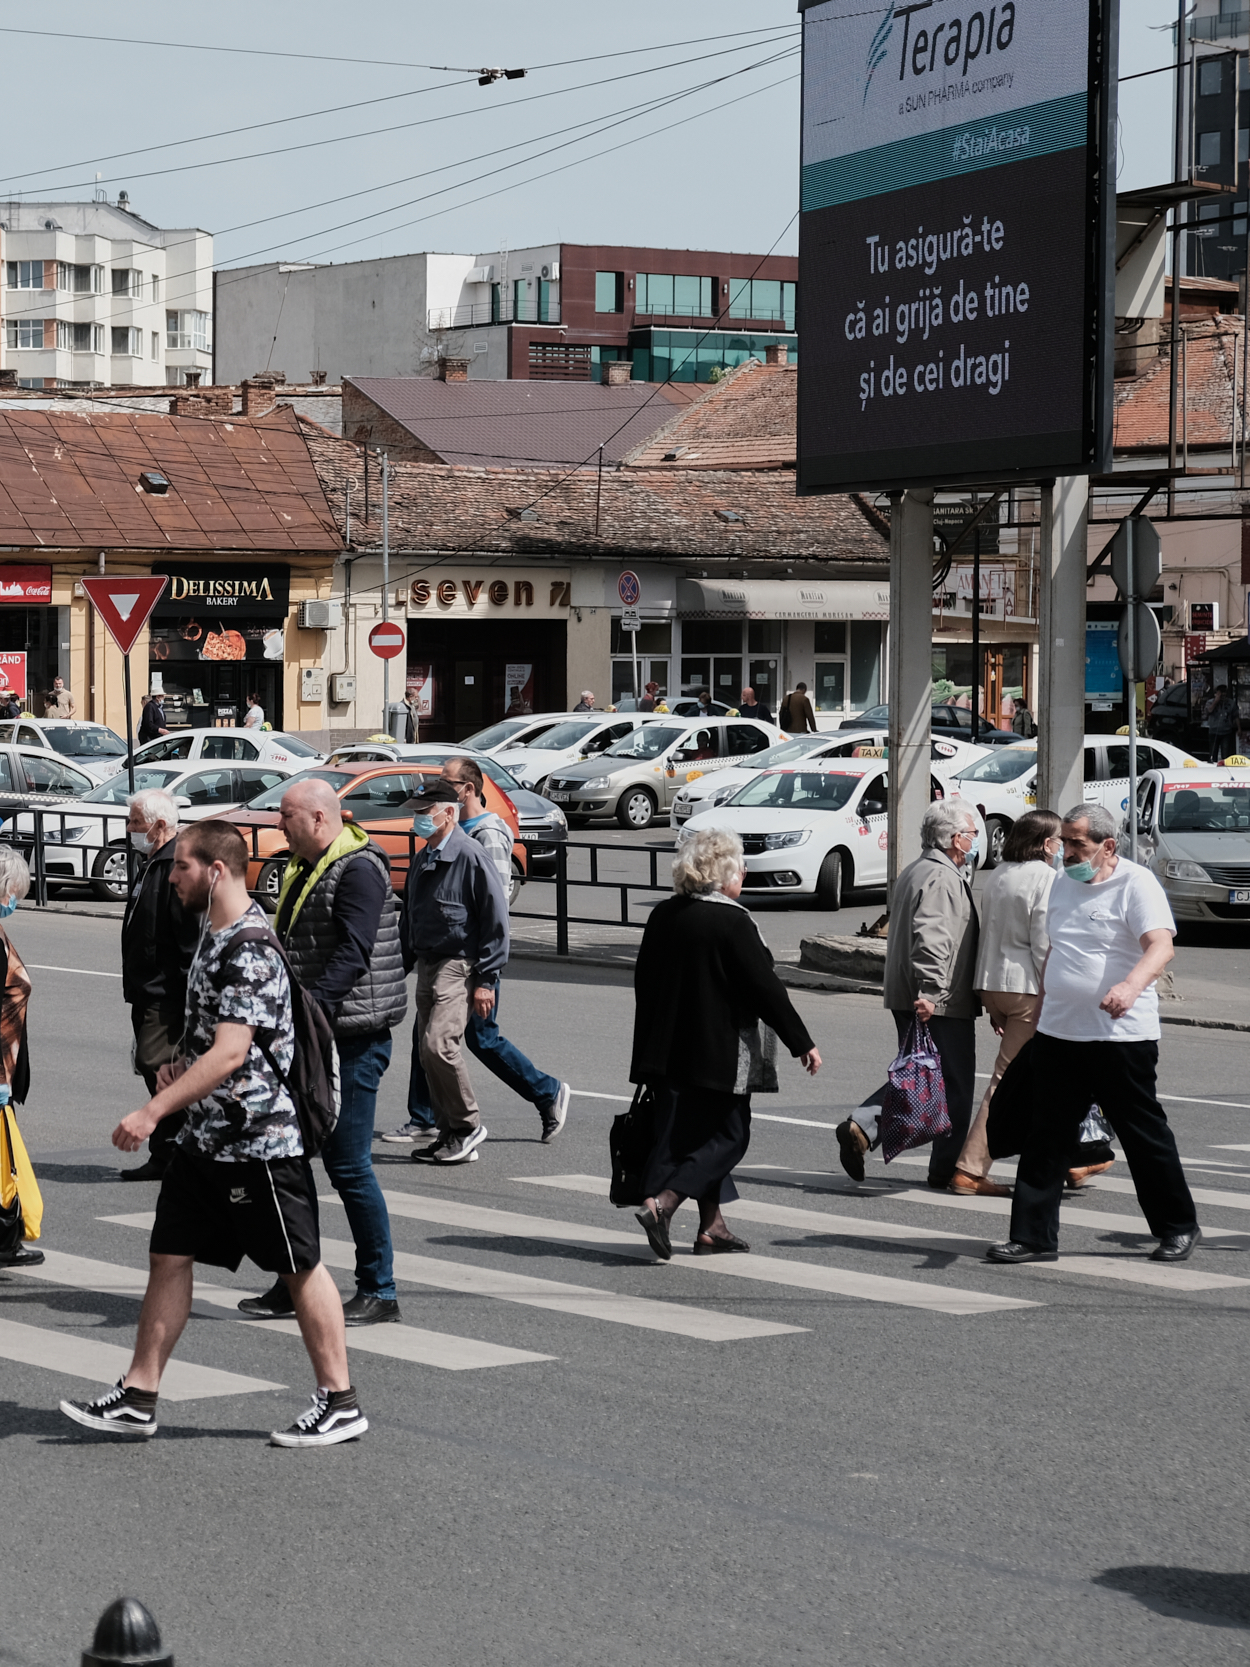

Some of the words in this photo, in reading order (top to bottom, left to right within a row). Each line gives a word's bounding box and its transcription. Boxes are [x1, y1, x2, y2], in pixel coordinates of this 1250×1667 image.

[893, 0, 1015, 80] Terapia
[905, 94, 926, 113] SUN
[928, 81, 970, 106] PHARMA
[972, 71, 1014, 94] company
[952, 126, 1030, 162] #StaiAcasa
[866, 235, 889, 274] Tu
[895, 214, 1005, 275] asigură-te
[844, 300, 866, 340] că
[872, 296, 890, 336] ai
[896, 286, 943, 344] grijă
[950, 279, 978, 323] de
[984, 275, 1030, 318] tine
[859, 360, 875, 411] și
[880, 355, 908, 397] de
[914, 350, 944, 393] cei
[951, 340, 1010, 396] dragi
[206, 597, 238, 606] BAKERY
[410, 579, 535, 607] seven
[861, 748, 883, 757] TAXI
[1230, 757, 1246, 766] TAXI
[230, 1187, 246, 1196] NIKE
